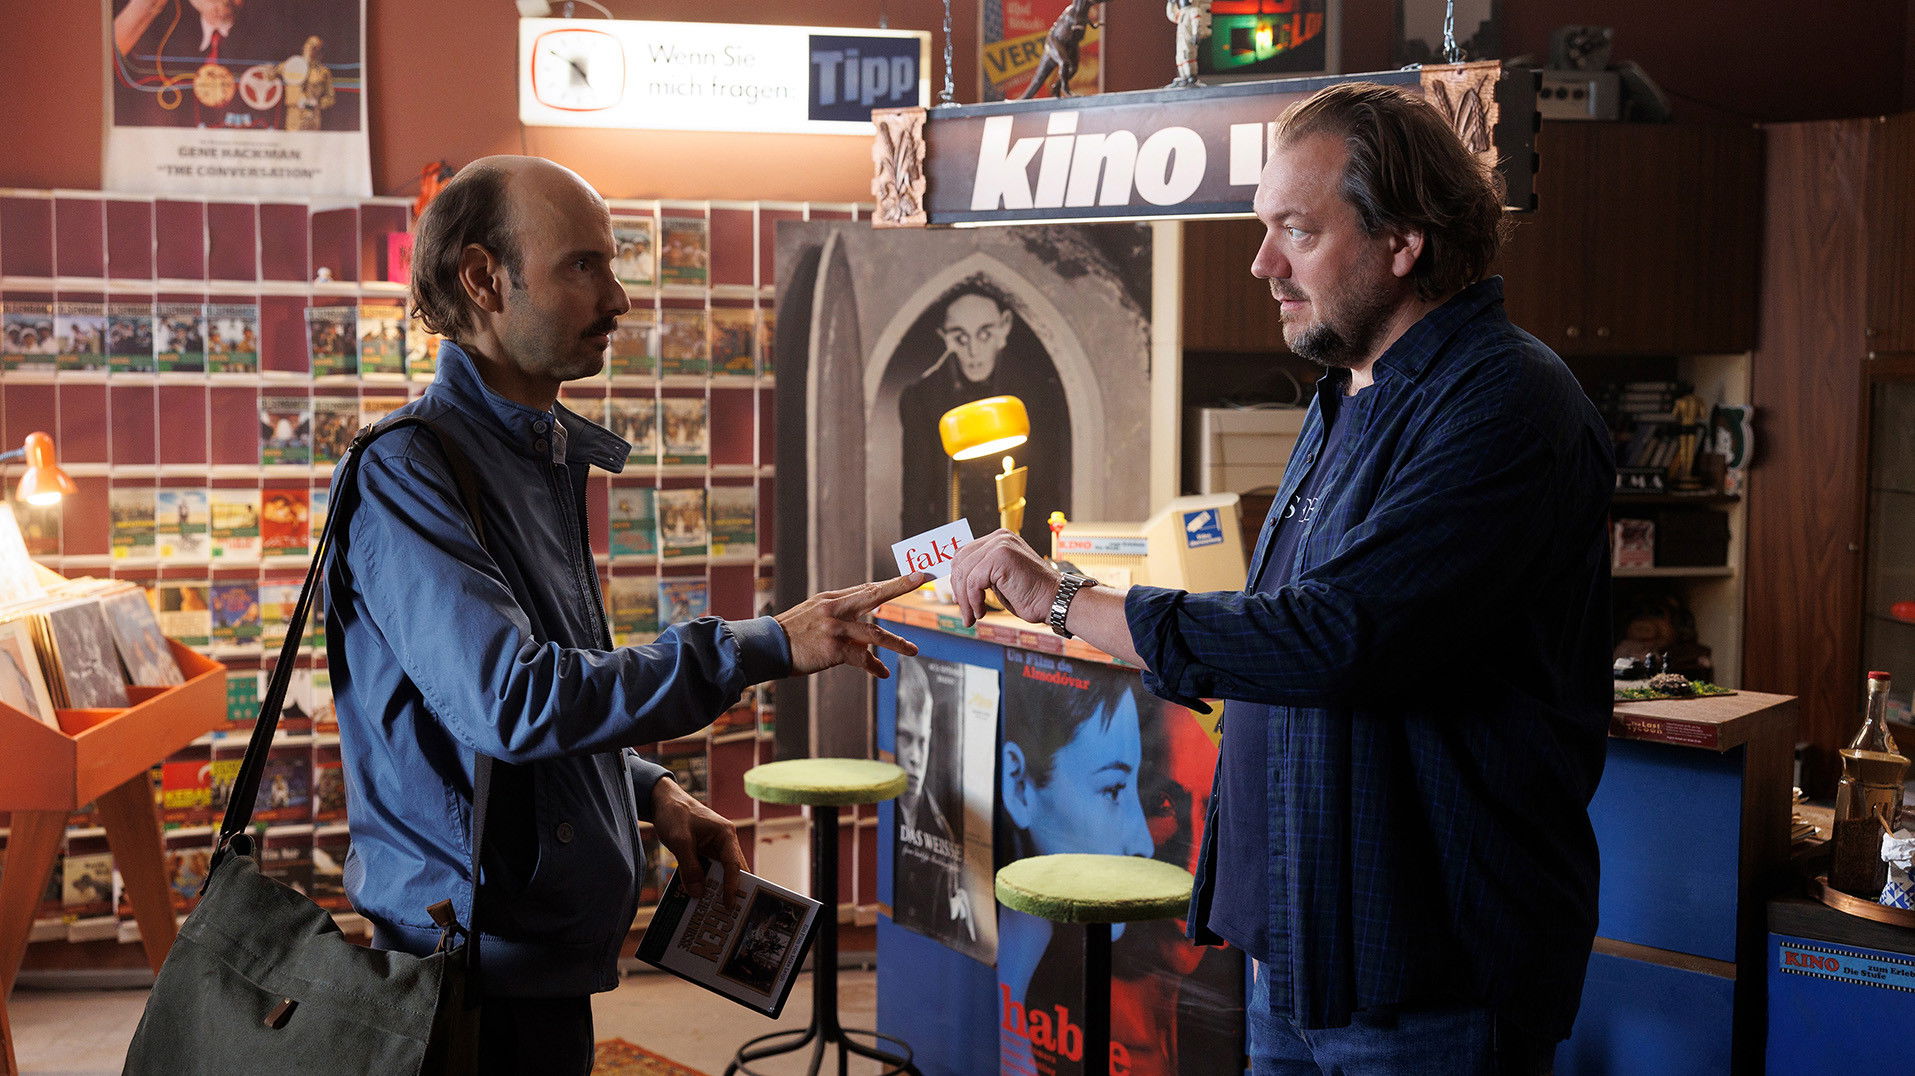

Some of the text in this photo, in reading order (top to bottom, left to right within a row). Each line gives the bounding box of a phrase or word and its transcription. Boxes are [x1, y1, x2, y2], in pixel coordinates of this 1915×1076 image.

[648, 44, 755, 66] Wenn Sie
[987, 36, 1046, 73] VER
[649, 74, 702, 96] mich
[812, 49, 914, 105] Tipp
[178, 147, 302, 160] GENE HACKMAN
[970, 111, 1207, 211] kino
[905, 536, 962, 573] fakt
[900, 824, 923, 847] DAS
[1785, 952, 1840, 972] KINO
[1843, 967, 1859, 976] Die
[999, 983, 1132, 1076] habe
